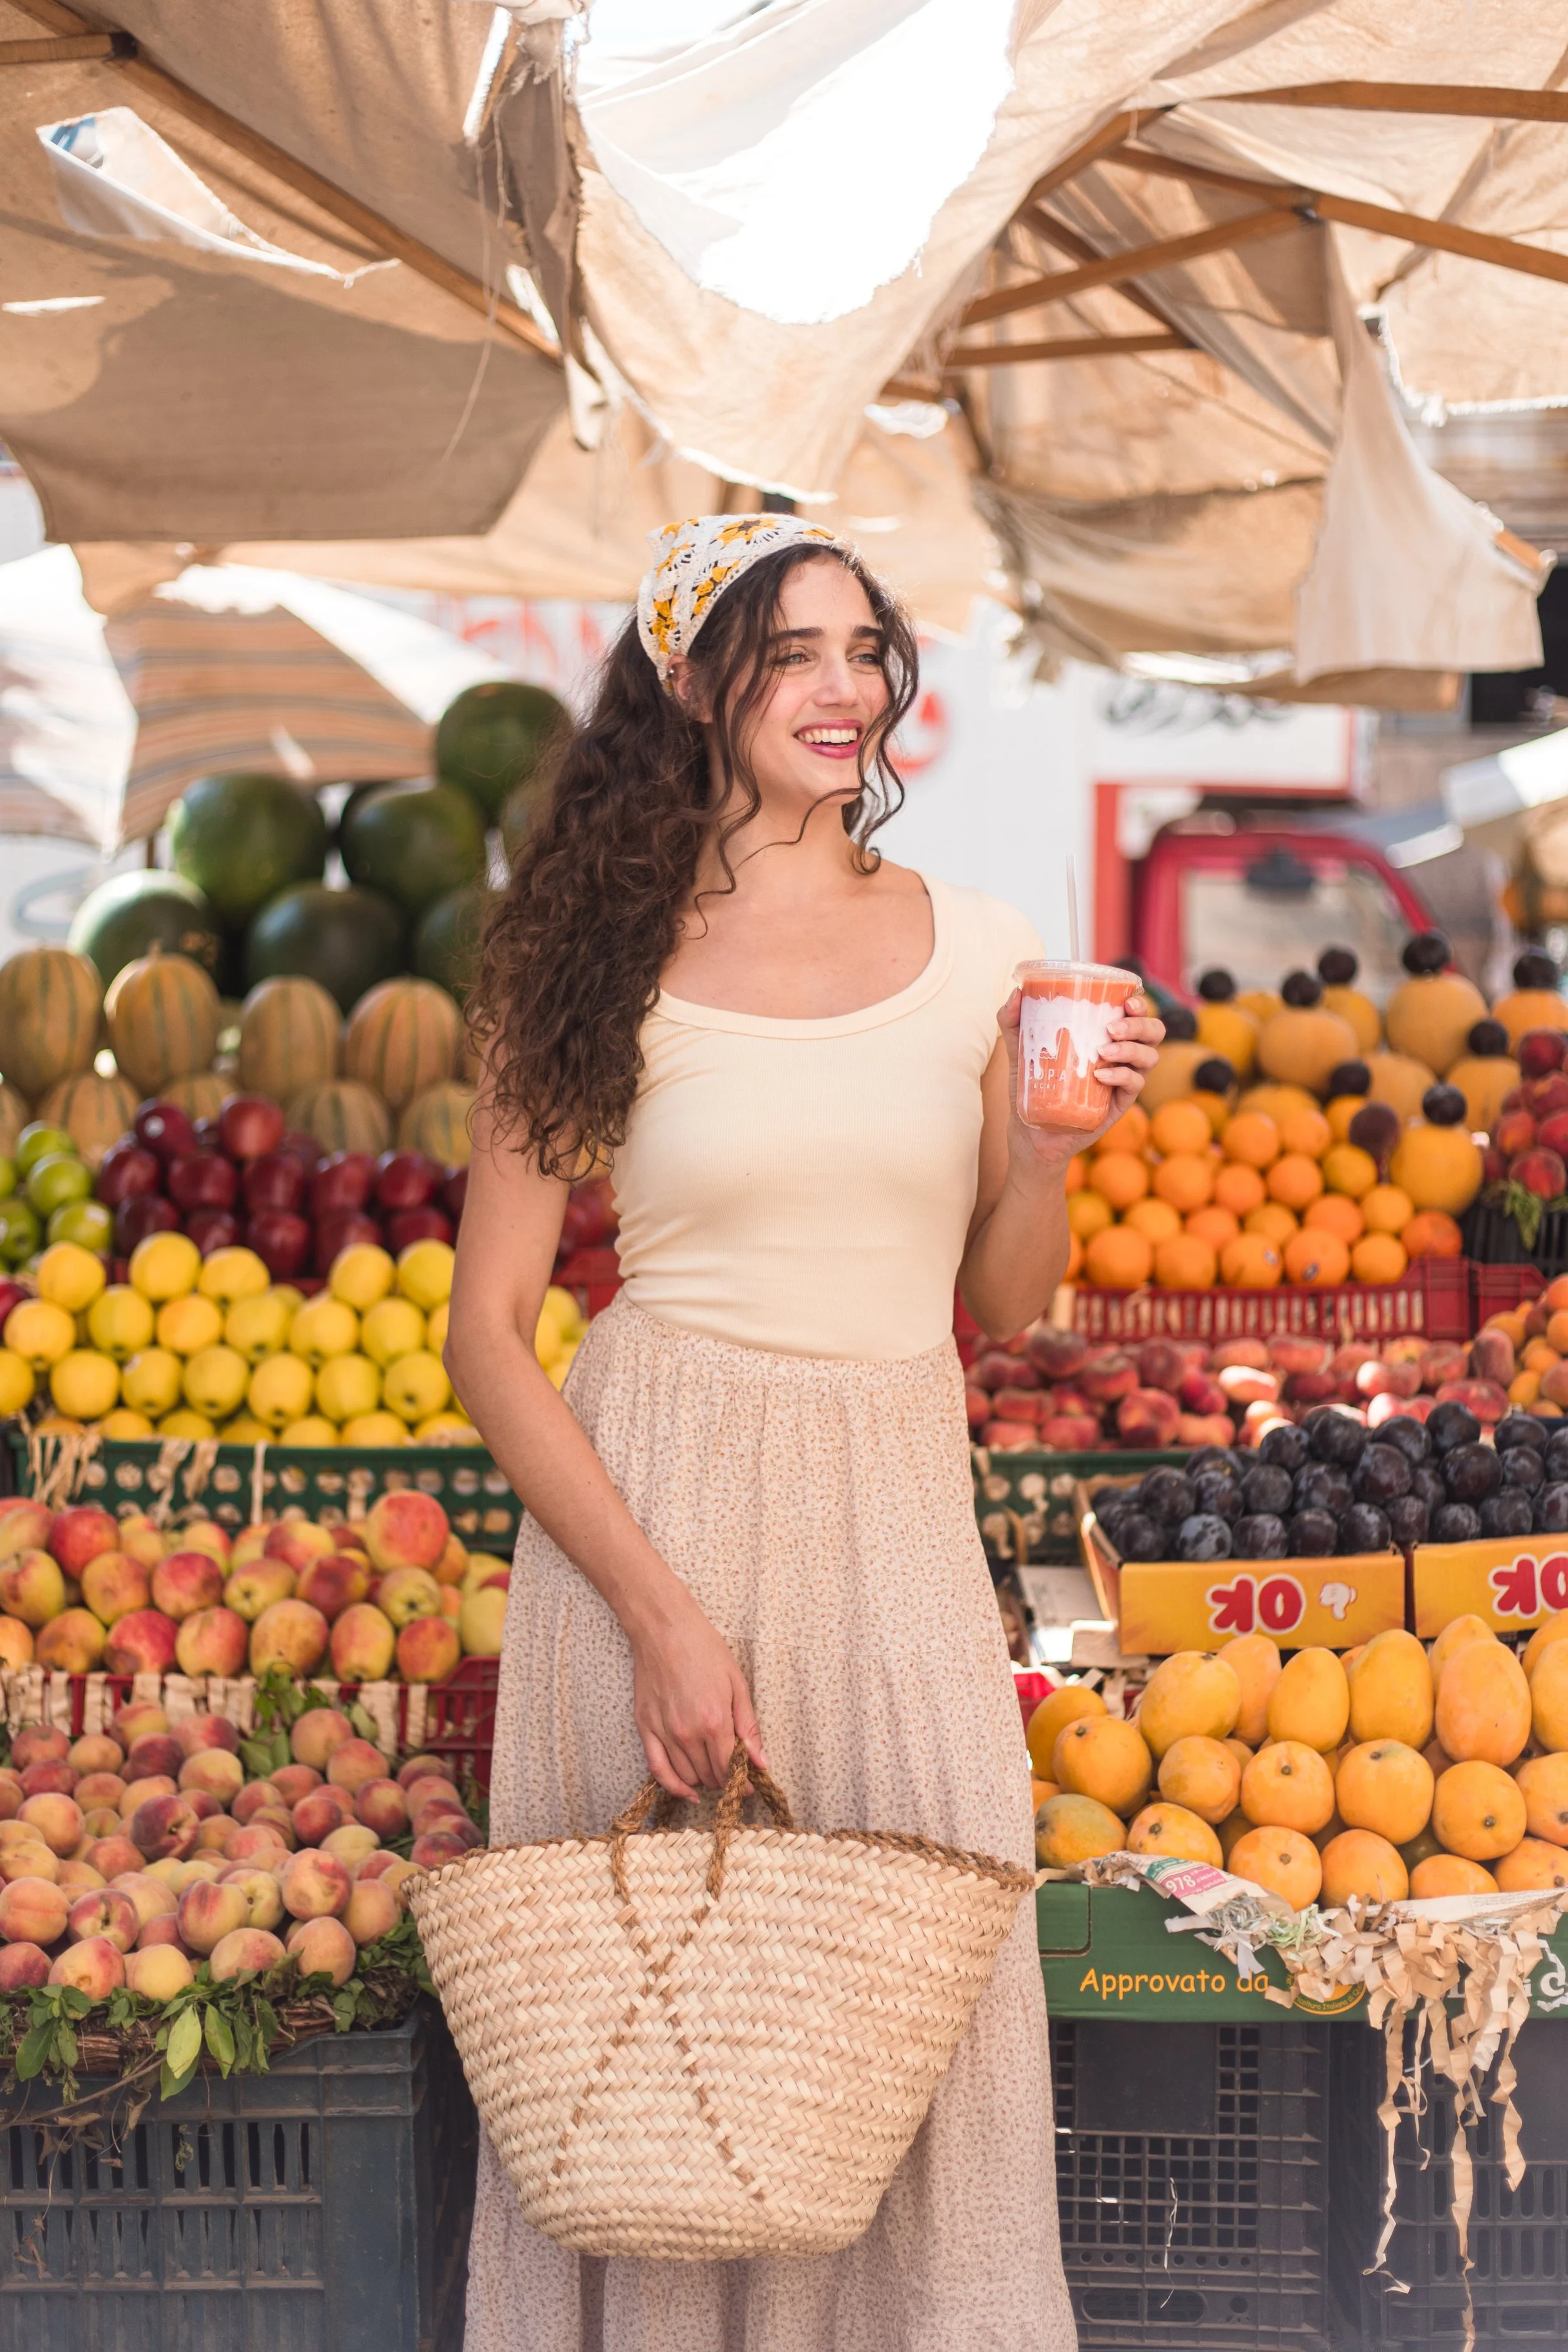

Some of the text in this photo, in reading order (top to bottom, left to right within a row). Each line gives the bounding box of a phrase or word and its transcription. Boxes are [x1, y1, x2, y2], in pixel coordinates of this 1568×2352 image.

[1027, 1068, 1067, 1082] COPA
[1205, 1573, 1306, 1637] OK
[1165, 1874, 1196, 1893] 978
[1079, 1968, 1226, 2000] Approvato
[1236, 1968, 1269, 1993] da
